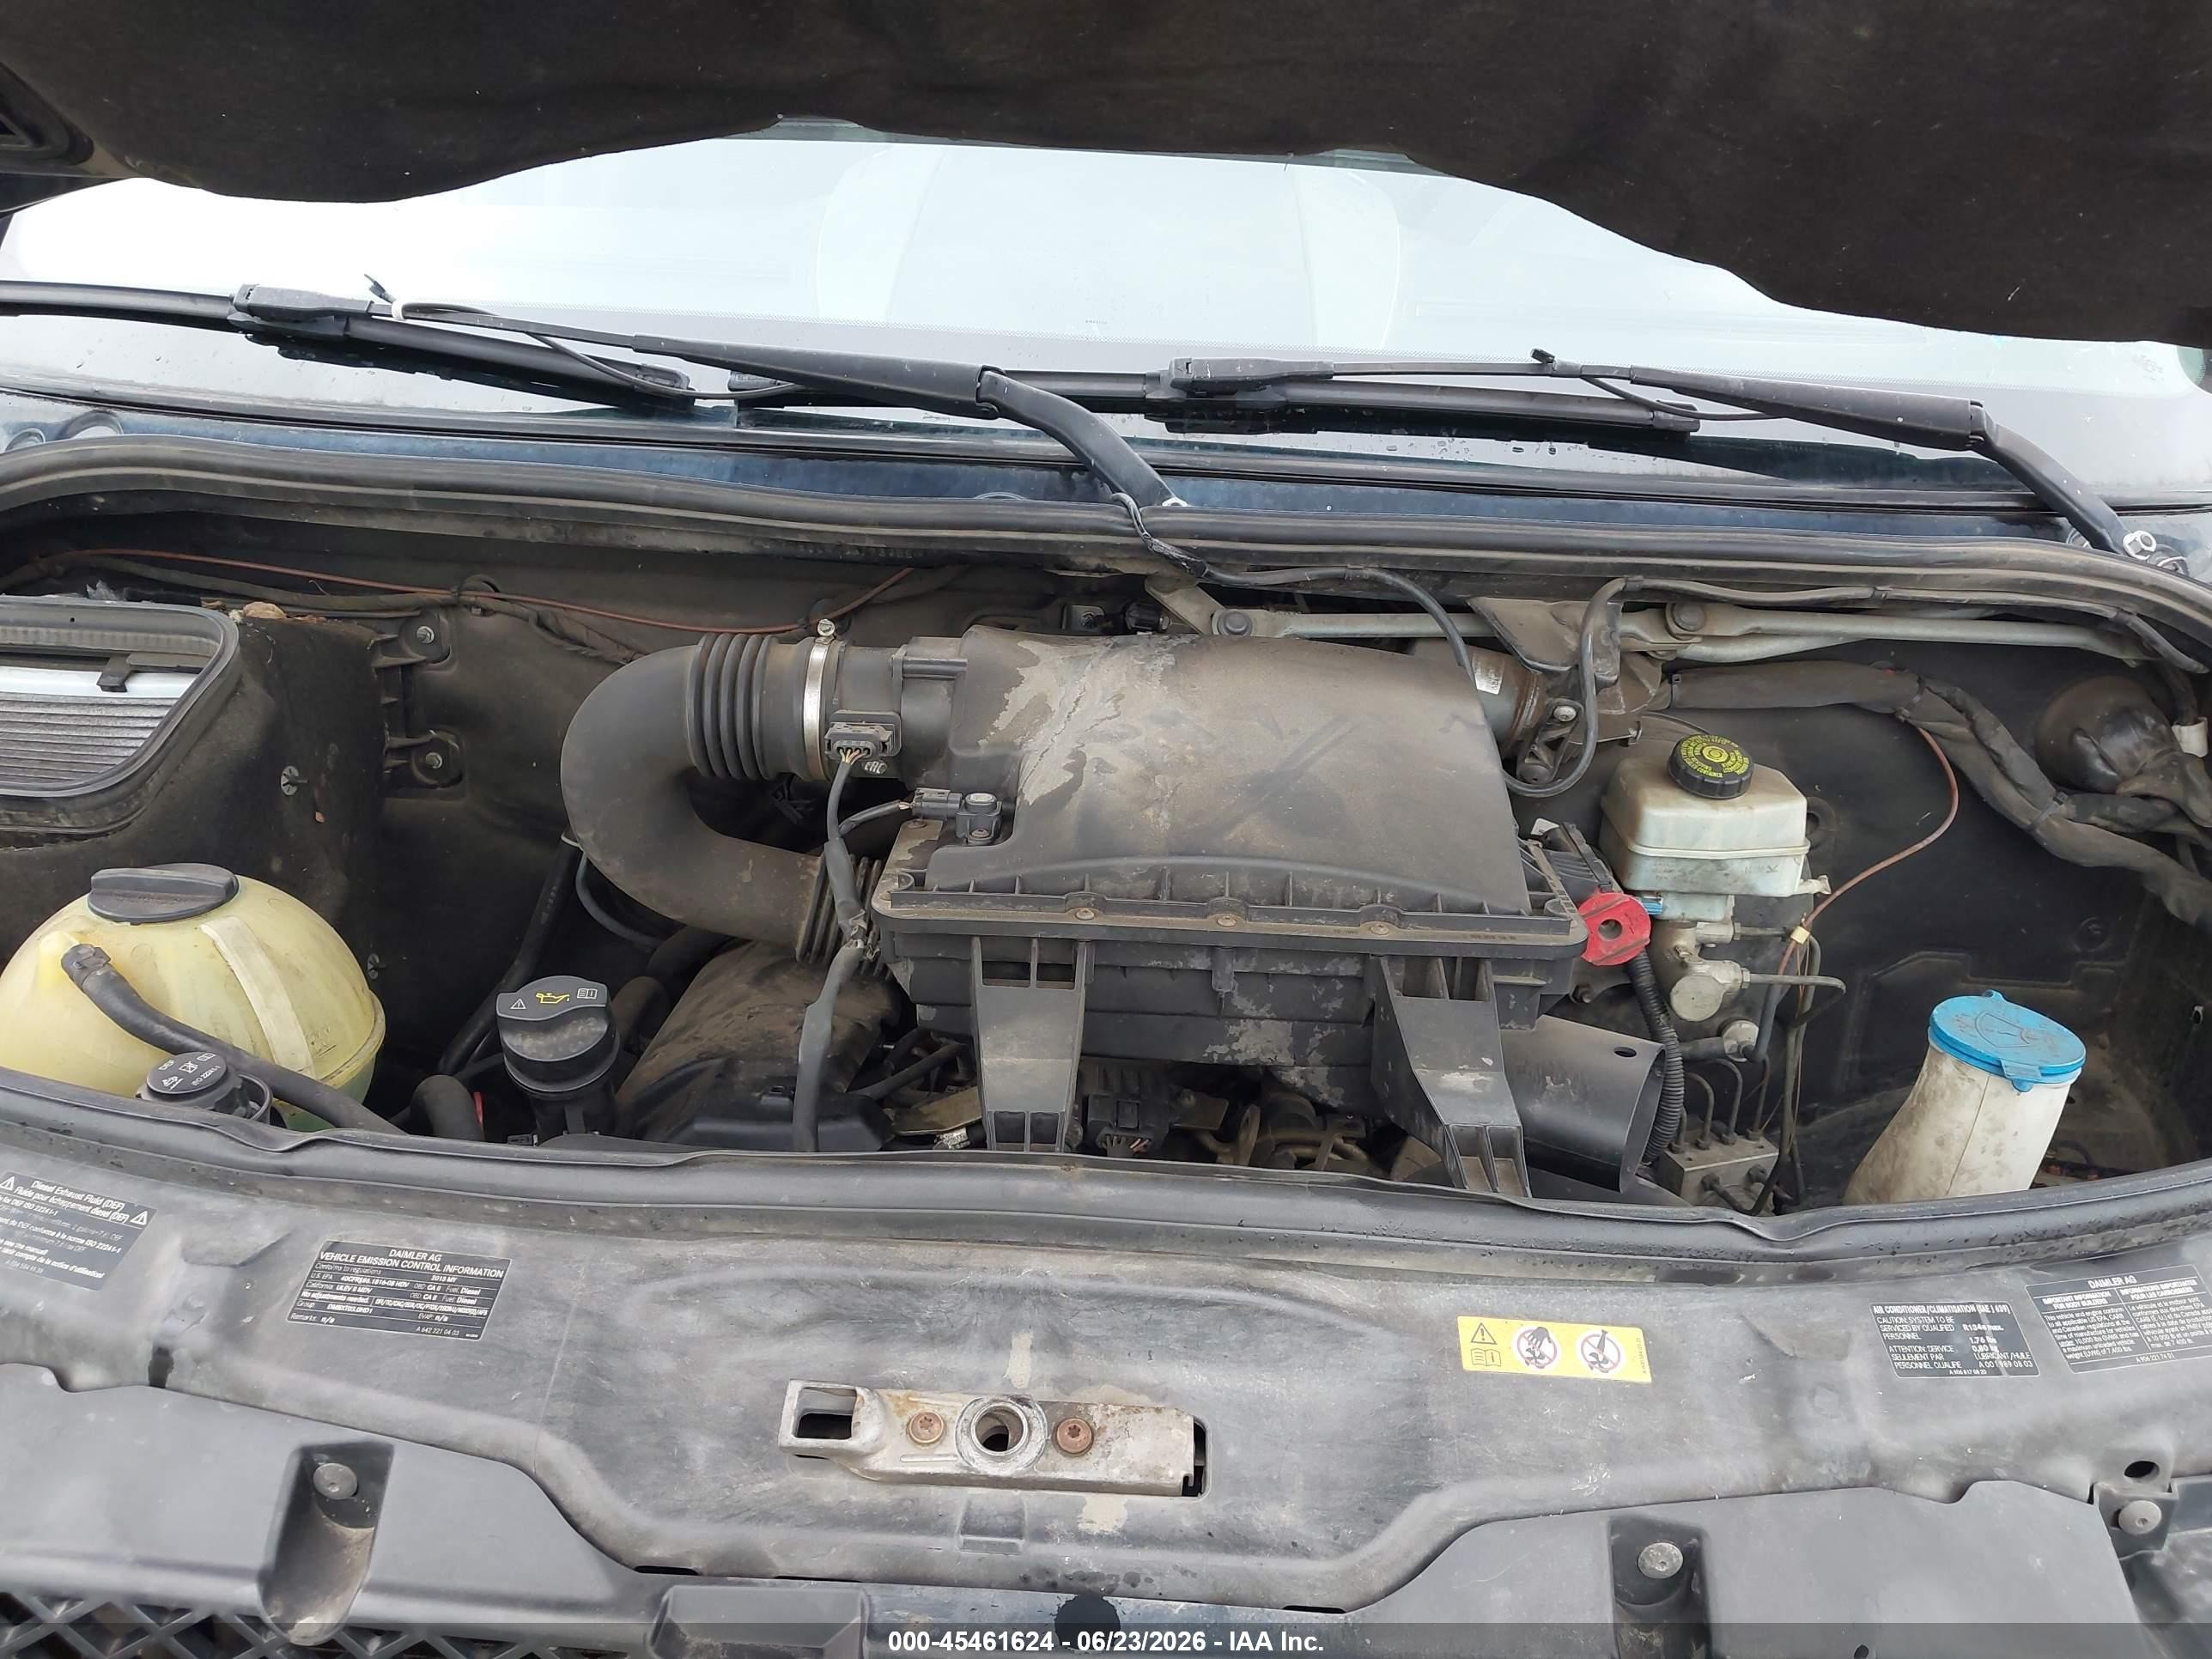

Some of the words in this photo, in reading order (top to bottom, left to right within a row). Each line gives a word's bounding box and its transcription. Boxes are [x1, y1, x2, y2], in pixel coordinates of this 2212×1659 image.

[157, 1060, 175, 1071] DEF
[31, 1181, 56, 1192] Diesel
[54, 1187, 84, 1200] Exhaust
[83, 1194, 104, 1205] Fluid
[102, 1200, 125, 1212] (DEF)
[14, 1187, 34, 1197] Fluide
[90, 1207, 112, 1217] diesel
[109, 1212, 130, 1223] (DEF)
[33, 1206, 58, 1215] 22241-1
[29, 1226, 56, 1237] conforme
[95, 1243, 121, 1253] 22241-1
[389, 1249, 428, 1260] DAIMLER
[320, 1252, 356, 1262] VEHICLE
[357, 1255, 399, 1267] EMISSION
[401, 1261, 441, 1271] CONTROL
[443, 1265, 503, 1278] INFORMATION
[2088, 1277, 2124, 1288] DAIMLER
[2124, 1275, 2136, 1284] AG
[2043, 1296, 2074, 1304] IMPORTANT
[2074, 1291, 2112, 1300] INFORMATION
[1885, 1304, 1976, 1314] CONDITIONER/CLIMATISATION
